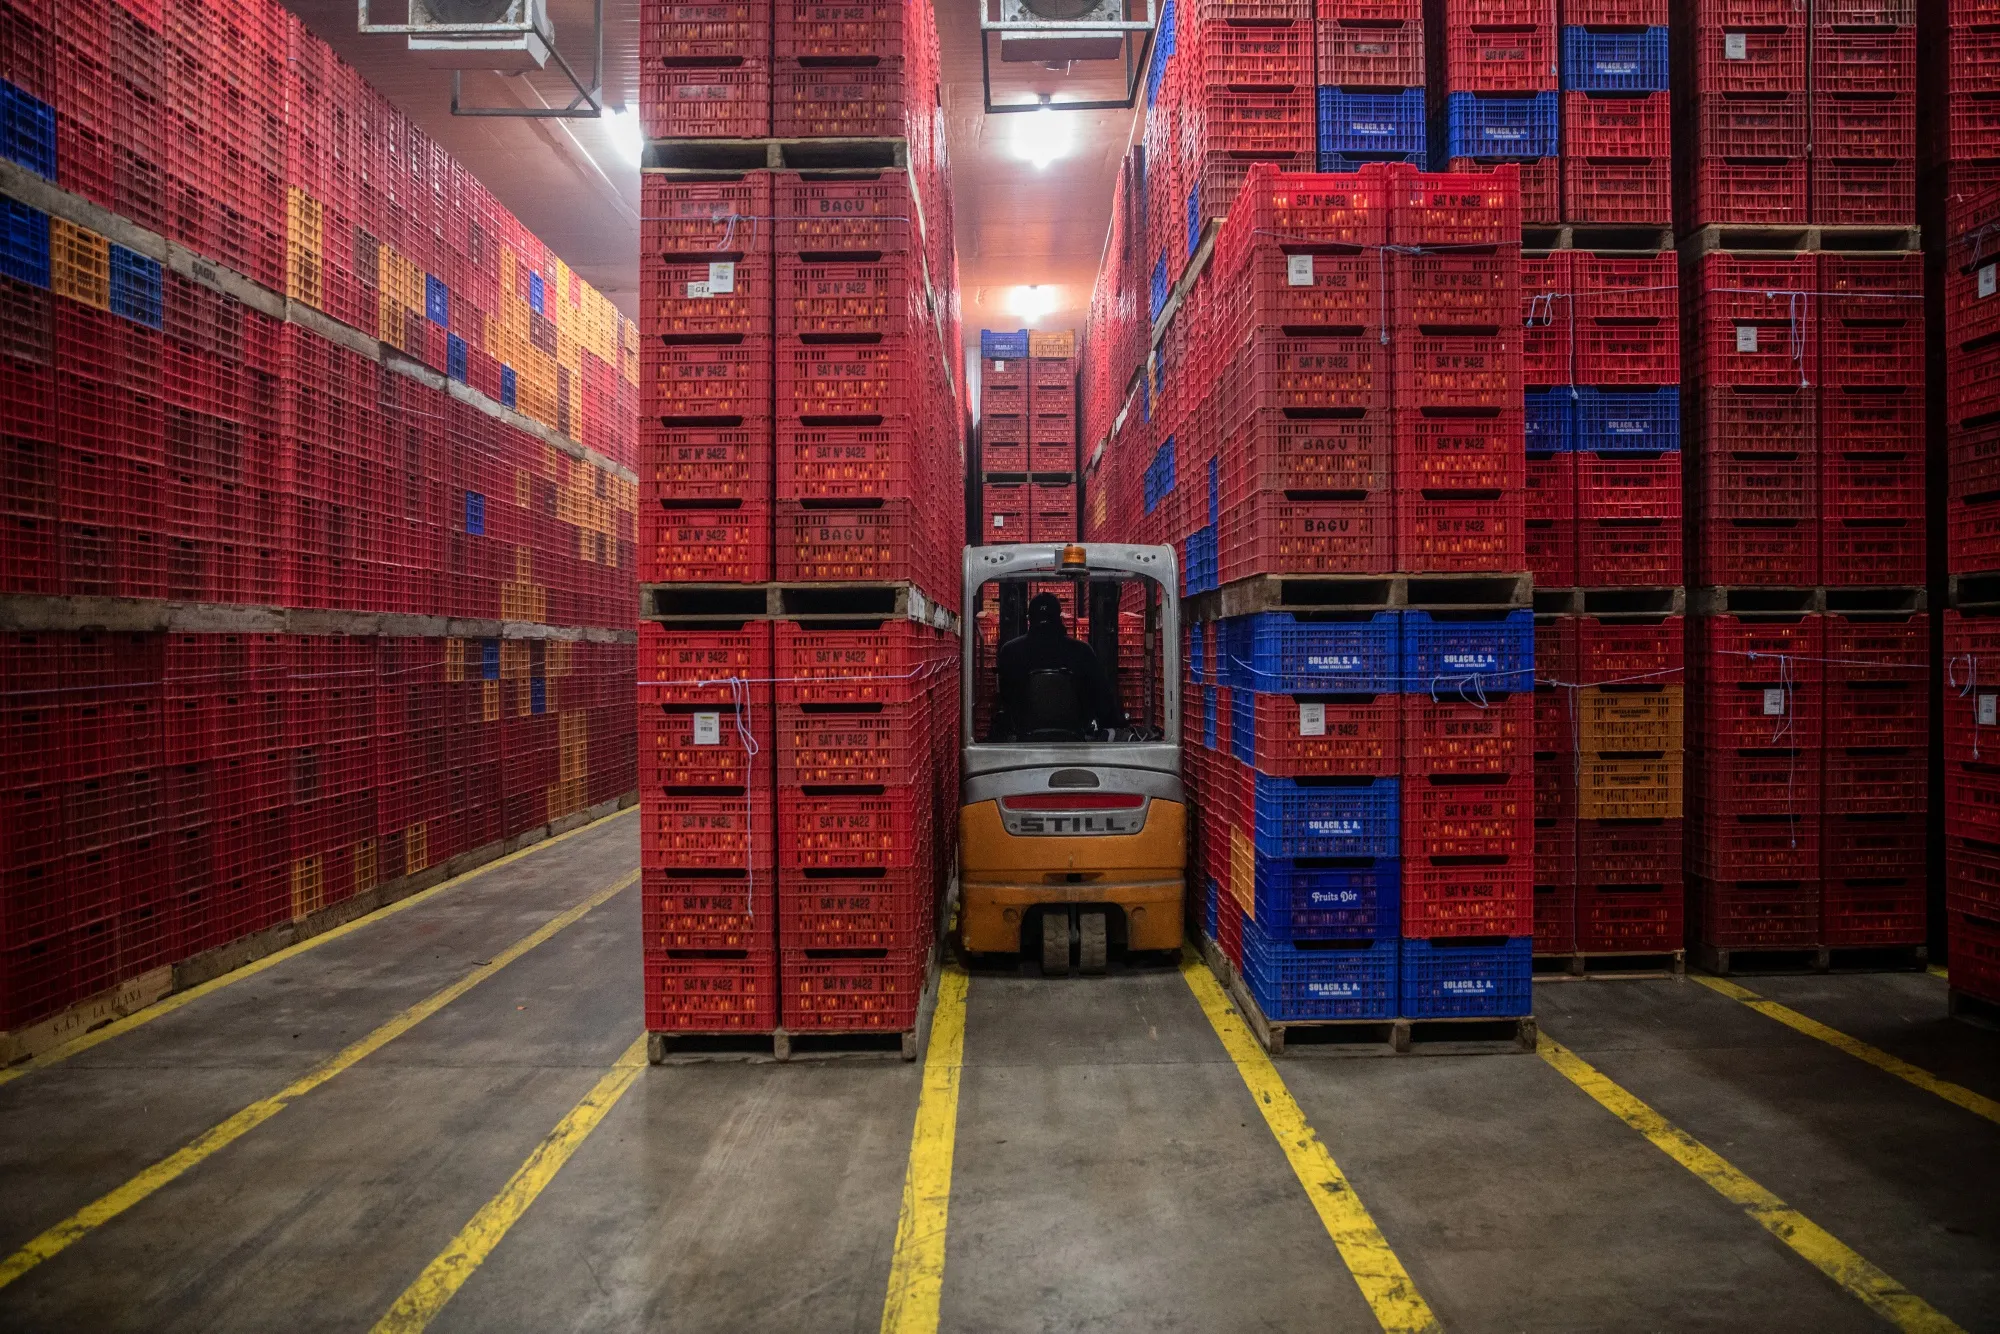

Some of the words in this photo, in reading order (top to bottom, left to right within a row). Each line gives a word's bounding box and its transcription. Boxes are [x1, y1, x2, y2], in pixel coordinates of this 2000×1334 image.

[816, 7, 829, 19] SAT
[844, 7, 864, 19] 9422
[1240, 44, 1251, 54] SAT
[1264, 44, 1280, 54] 9422
[1297, 195, 1310, 206] SAT
[1326, 195, 1345, 206] 9422
[1433, 195, 1446, 206] SAT
[1461, 195, 1481, 206] 9422
[1327, 275, 1347, 286] 9422
[1434, 274, 1447, 286] SAT
[1463, 274, 1482, 286] 9422
[817, 283, 830, 294] SAT
[846, 283, 866, 294] 9422
[1299, 356, 1312, 367] SAT
[1328, 356, 1348, 367] 9422
[1436, 356, 1449, 367] SAT
[1465, 356, 1484, 367] 9422
[679, 365, 692, 377] SAT
[707, 365, 727, 377] 9422
[817, 365, 830, 376] SAT
[846, 365, 866, 376] 9422
[1437, 438, 1450, 449] SAT
[1465, 438, 1484, 449] 9422
[678, 448, 691, 460] SAT
[707, 448, 726, 460] 9422
[817, 447, 830, 458] SAT
[846, 447, 865, 458] 9422
[1437, 520, 1450, 531] SAT
[1465, 520, 1484, 531] 9422
[678, 530, 691, 541] SAT
[707, 530, 726, 541] 9422
[679, 651, 693, 663] SAT
[708, 651, 727, 663] 9422
[816, 651, 830, 662] SAT
[846, 651, 865, 662] 9422
[1338, 724, 1358, 735] 9422
[1445, 723, 1458, 735] SAT
[1474, 723, 1494, 735] 9422
[819, 734, 832, 745] SAT
[848, 734, 868, 745] 9422
[1445, 804, 1458, 816] SAT
[1473, 804, 1493, 816] 9422
[682, 816, 696, 828] SAT
[711, 816, 731, 828] 9422
[820, 816, 834, 827] SAT
[849, 816, 869, 827] 9422
[1021, 818, 1125, 832] STILL
[1445, 885, 1458, 897] SAT
[1473, 885, 1493, 897] 9422
[1312, 891, 1338, 903] Fruits
[684, 898, 697, 909] SAT
[712, 898, 732, 909] 9422
[821, 898, 834, 909] SAT
[850, 898, 870, 909] 9422
[684, 979, 697, 990] SAT
[713, 979, 732, 990] 9422
[823, 978, 837, 989] SAT
[852, 978, 872, 989] 9422
[93, 1005, 105, 1018] LA
[111, 989, 142, 1010] PLANA
